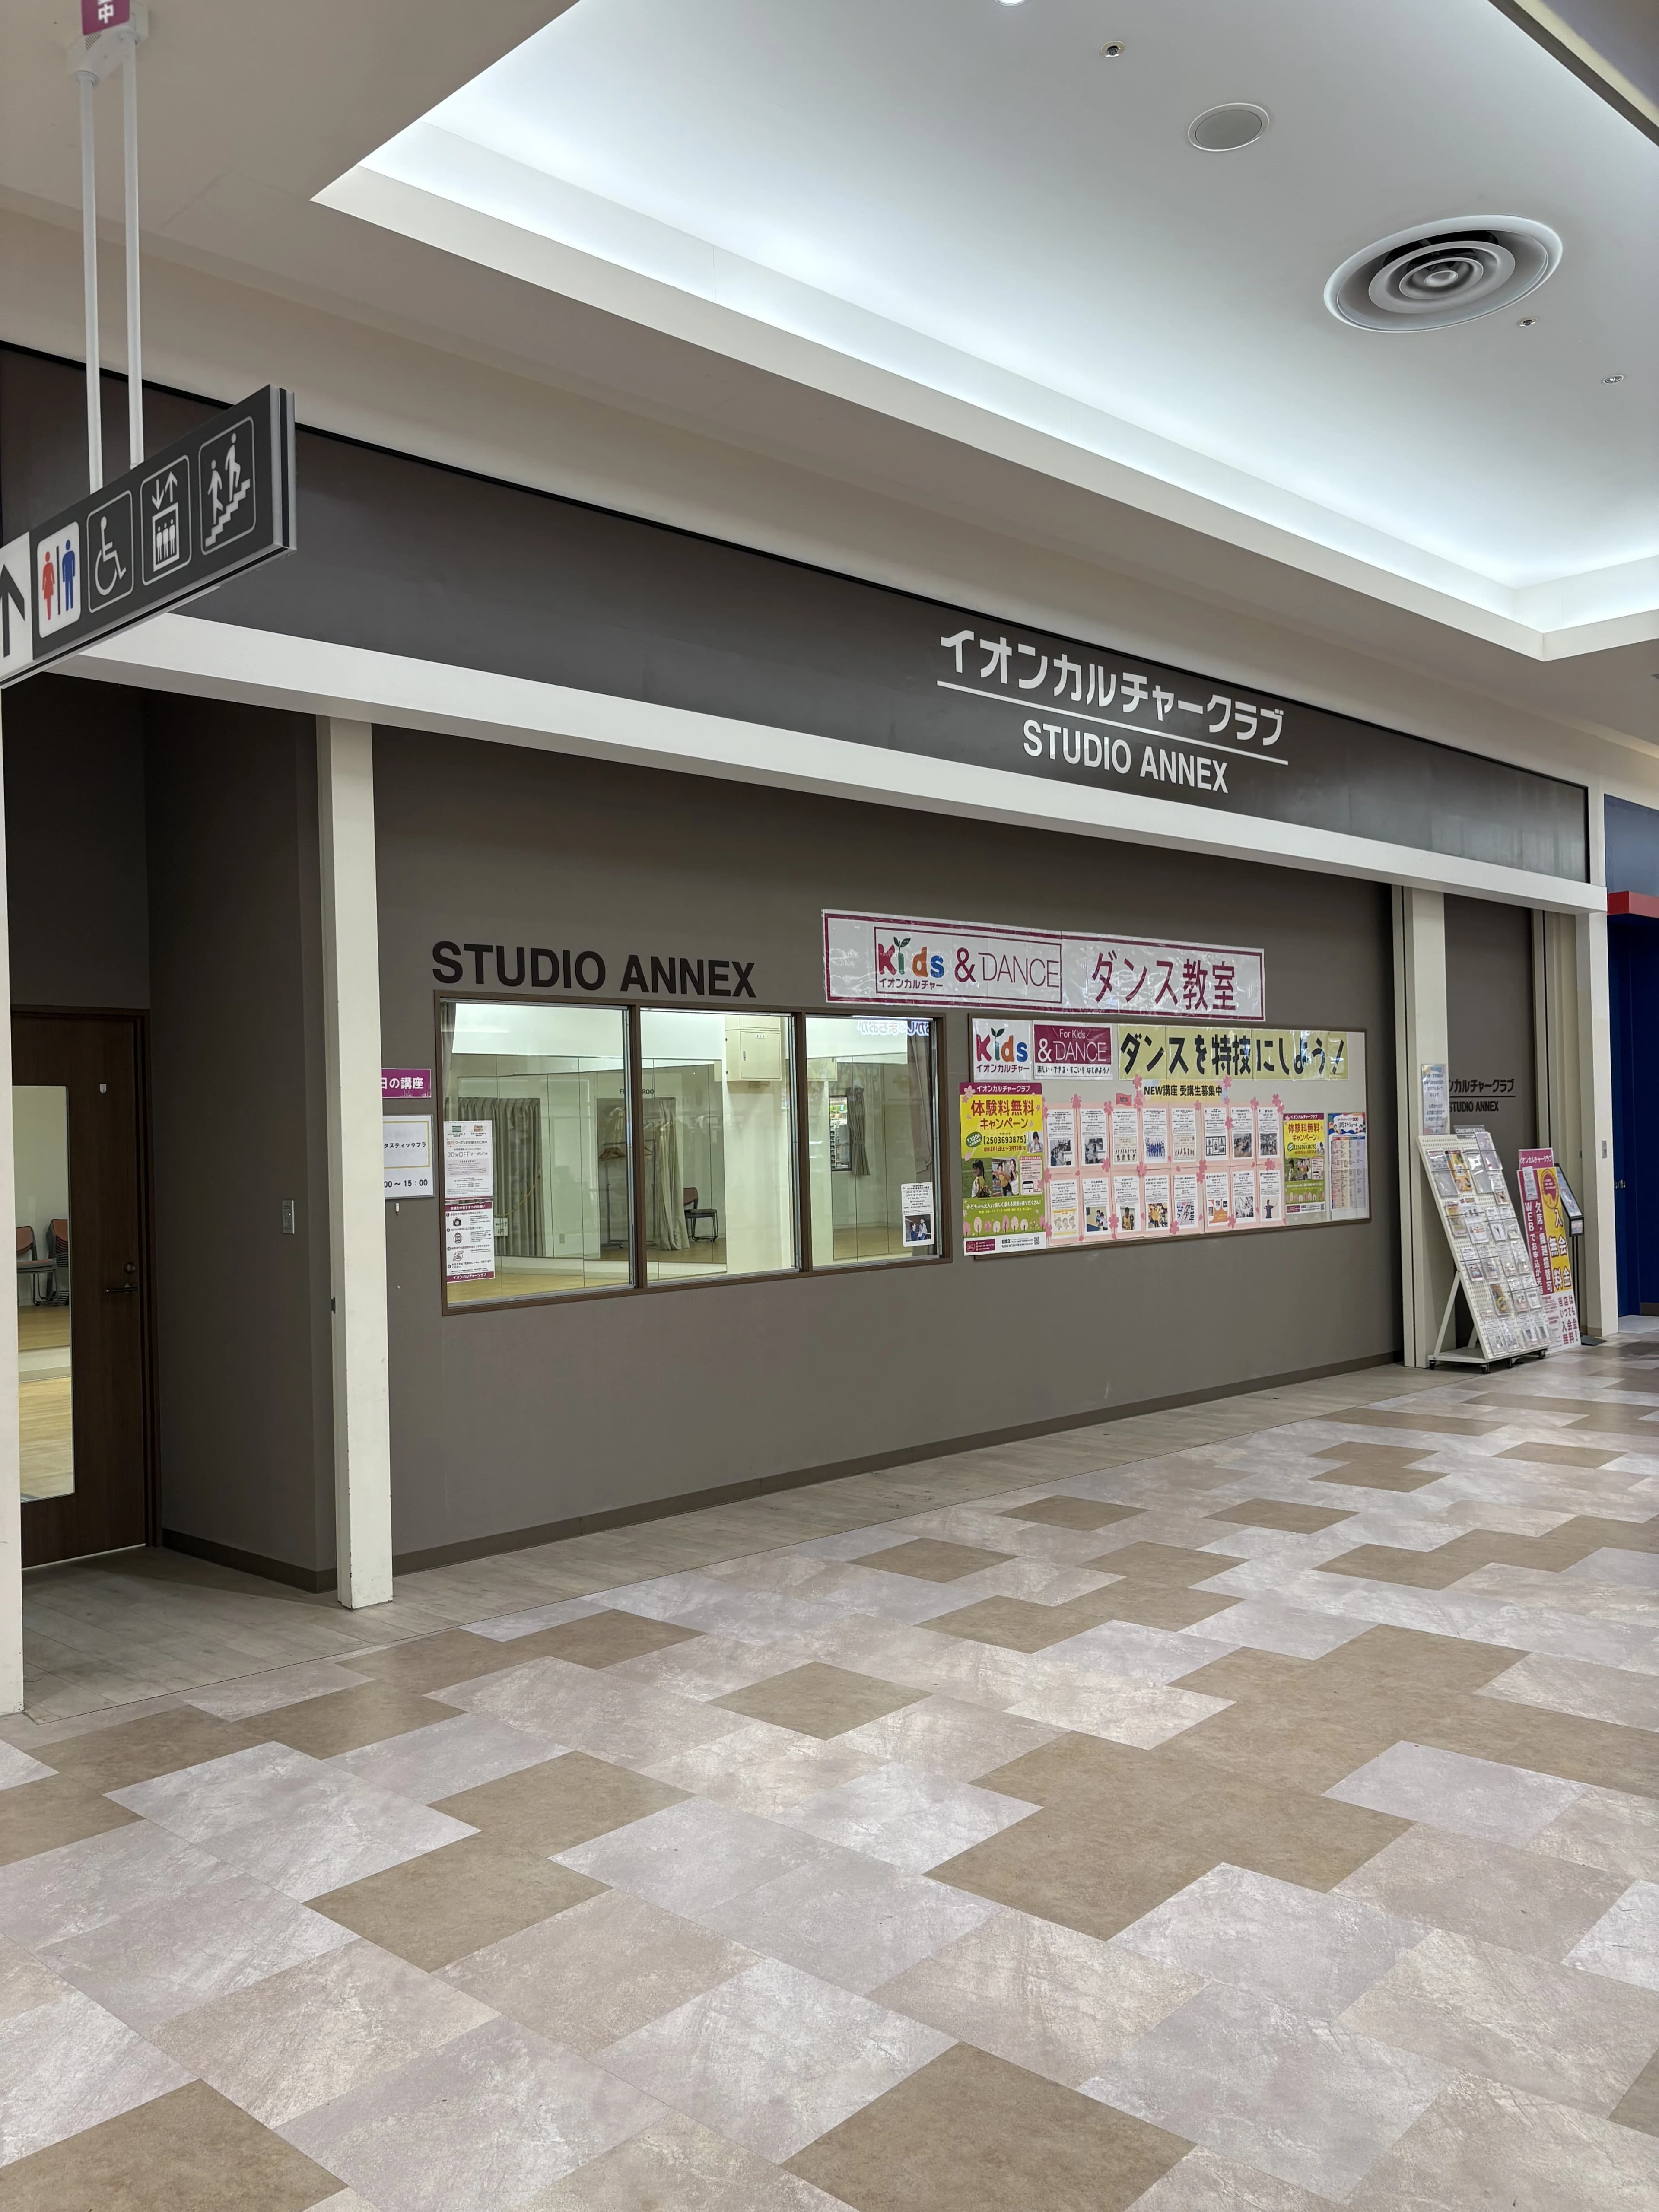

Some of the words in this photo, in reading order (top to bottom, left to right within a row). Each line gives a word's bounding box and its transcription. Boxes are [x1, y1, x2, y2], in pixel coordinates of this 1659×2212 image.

[941, 630, 1284, 746] イオンカルチャークラブ
[1023, 720, 1131, 774] STUDIO
[1140, 746, 1228, 793] ANNEX
[432, 941, 606, 991] STUDIO
[621, 954, 756, 998] ANNEX
[878, 940, 945, 978] Kids
[954, 947, 976, 983] &
[978, 952, 1059, 988] DANCE
[879, 978, 943, 989] イオンカルチャー
[1091, 950, 1236, 1011] ダンス教室
[1059, 1029, 1071, 1038] For
[1072, 1030, 1085, 1039] Kids
[976, 1029, 1028, 1062] Kids
[1038, 1038, 1052, 1062] &
[1053, 1041, 1106, 1062] DANCE
[976, 1064, 1030, 1073] イオンカルチャー
[381, 1077, 424, 1089] 日の講座
[1144, 1085, 1178, 1096] NEW講座
[1180, 1085, 1222, 1096] 受講生募集中
[971, 1099, 1034, 1116] 体験料無料
[1475, 1101, 1499, 1112] ANNEX
[980, 1117, 1028, 1130] キャンペーン
[1288, 1123, 1320, 1134] 体験料無料
[1560, 1307, 1576, 1318] いつでも
[1562, 1318, 1578, 1332] 入会金
